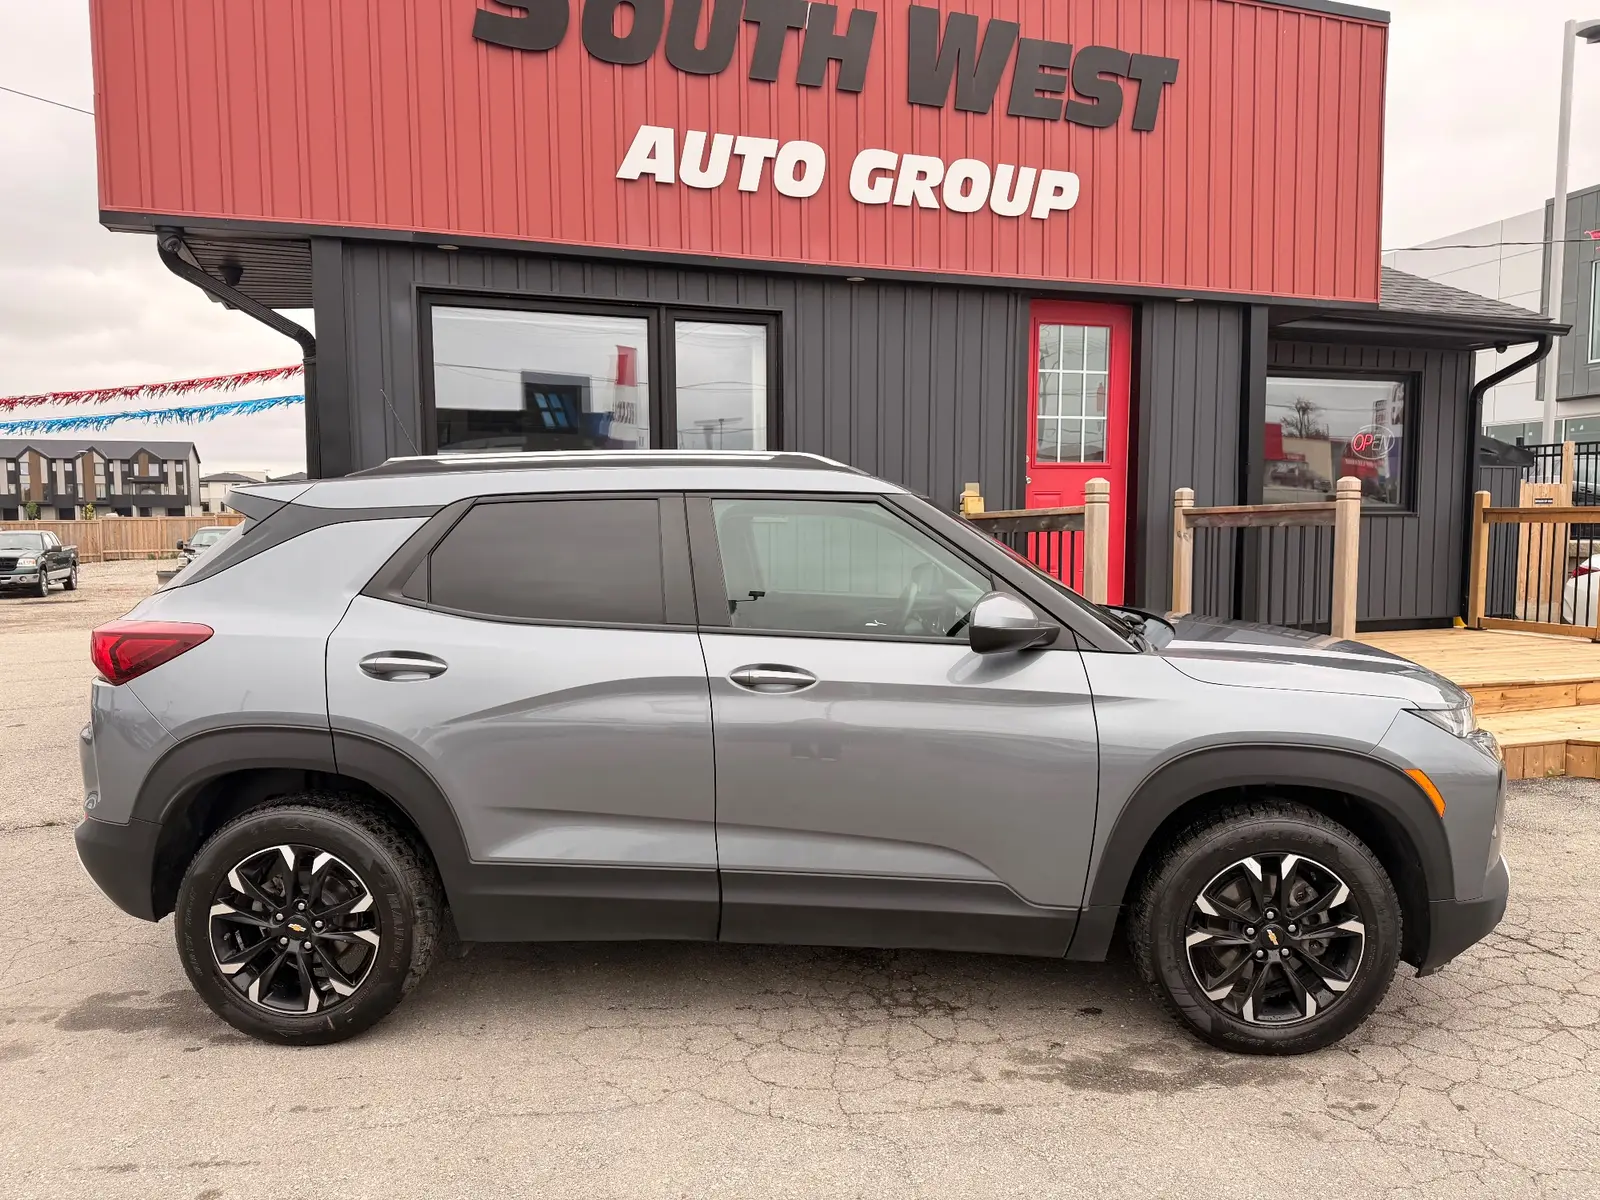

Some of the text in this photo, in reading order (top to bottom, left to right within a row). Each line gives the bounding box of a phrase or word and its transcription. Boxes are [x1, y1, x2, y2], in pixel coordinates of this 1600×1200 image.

[908, 4, 1180, 132] WEST
[616, 125, 1081, 220] AUTO GROUP
[1353, 433, 1392, 451] OPEN
